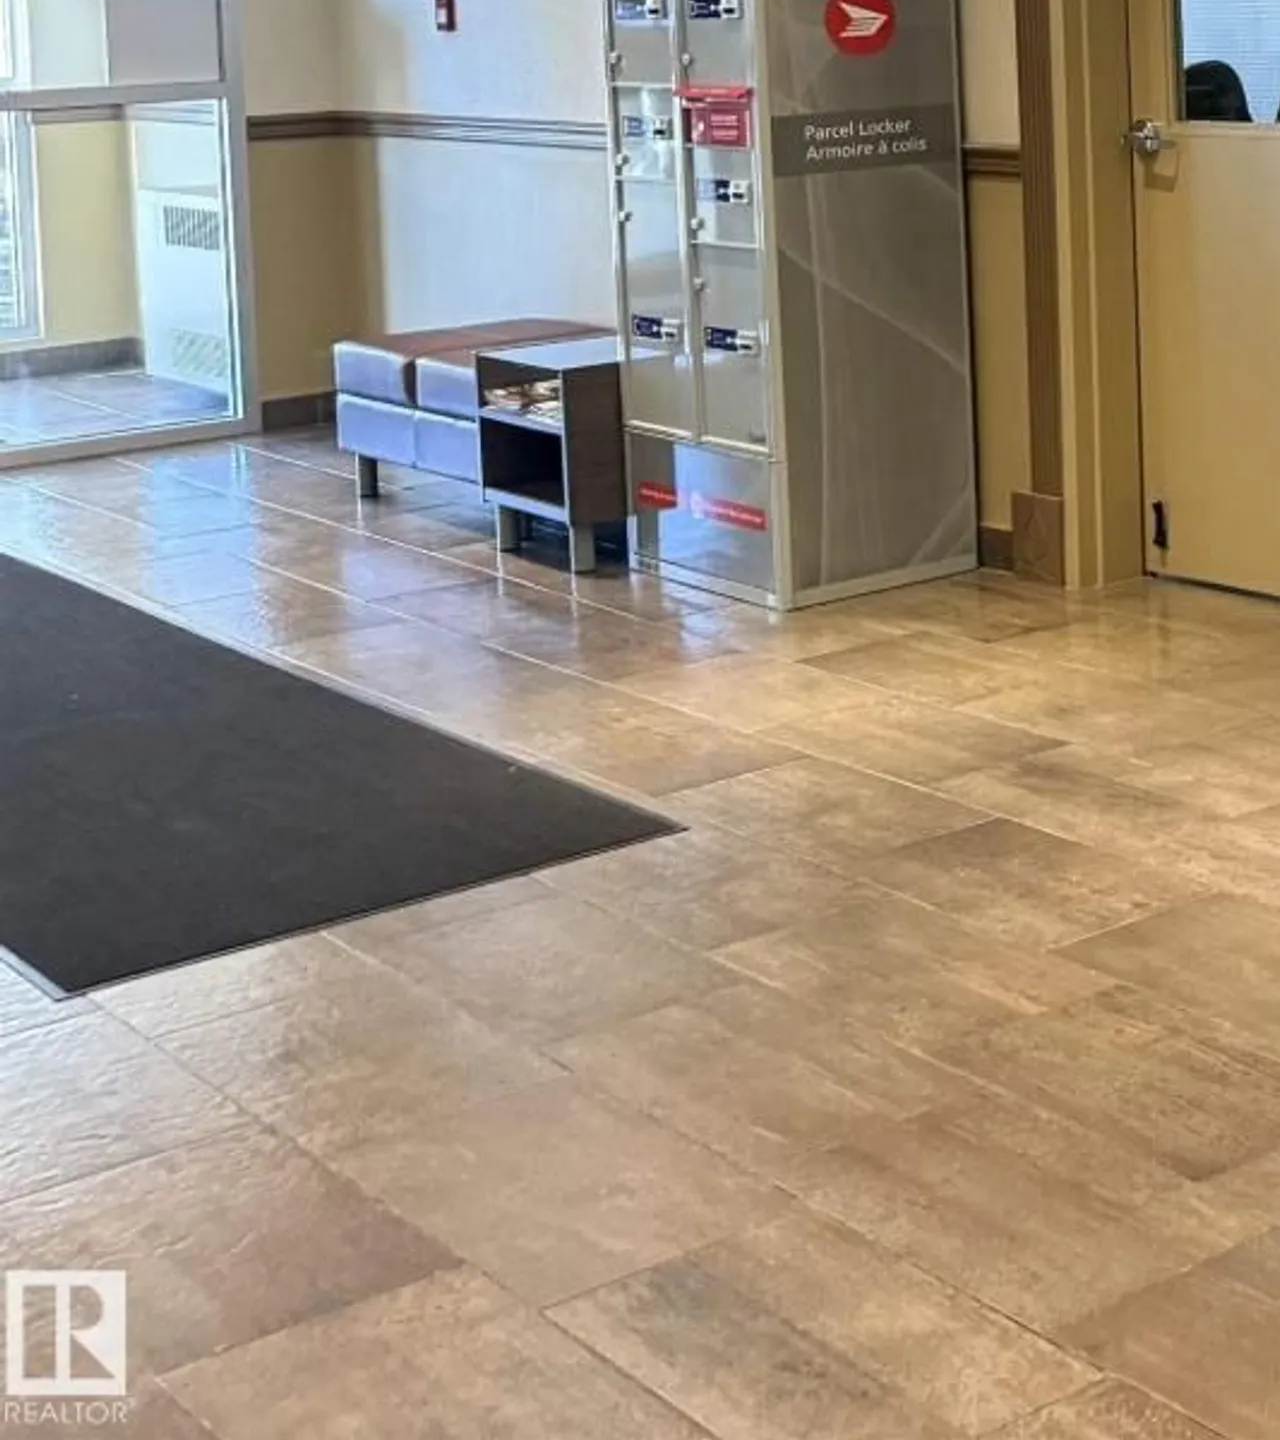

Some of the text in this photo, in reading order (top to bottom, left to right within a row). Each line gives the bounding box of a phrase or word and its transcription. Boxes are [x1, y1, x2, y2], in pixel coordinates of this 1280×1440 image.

[804, 118, 911, 140] Parcel Locker
[806, 136, 927, 160] Armoire à colis
